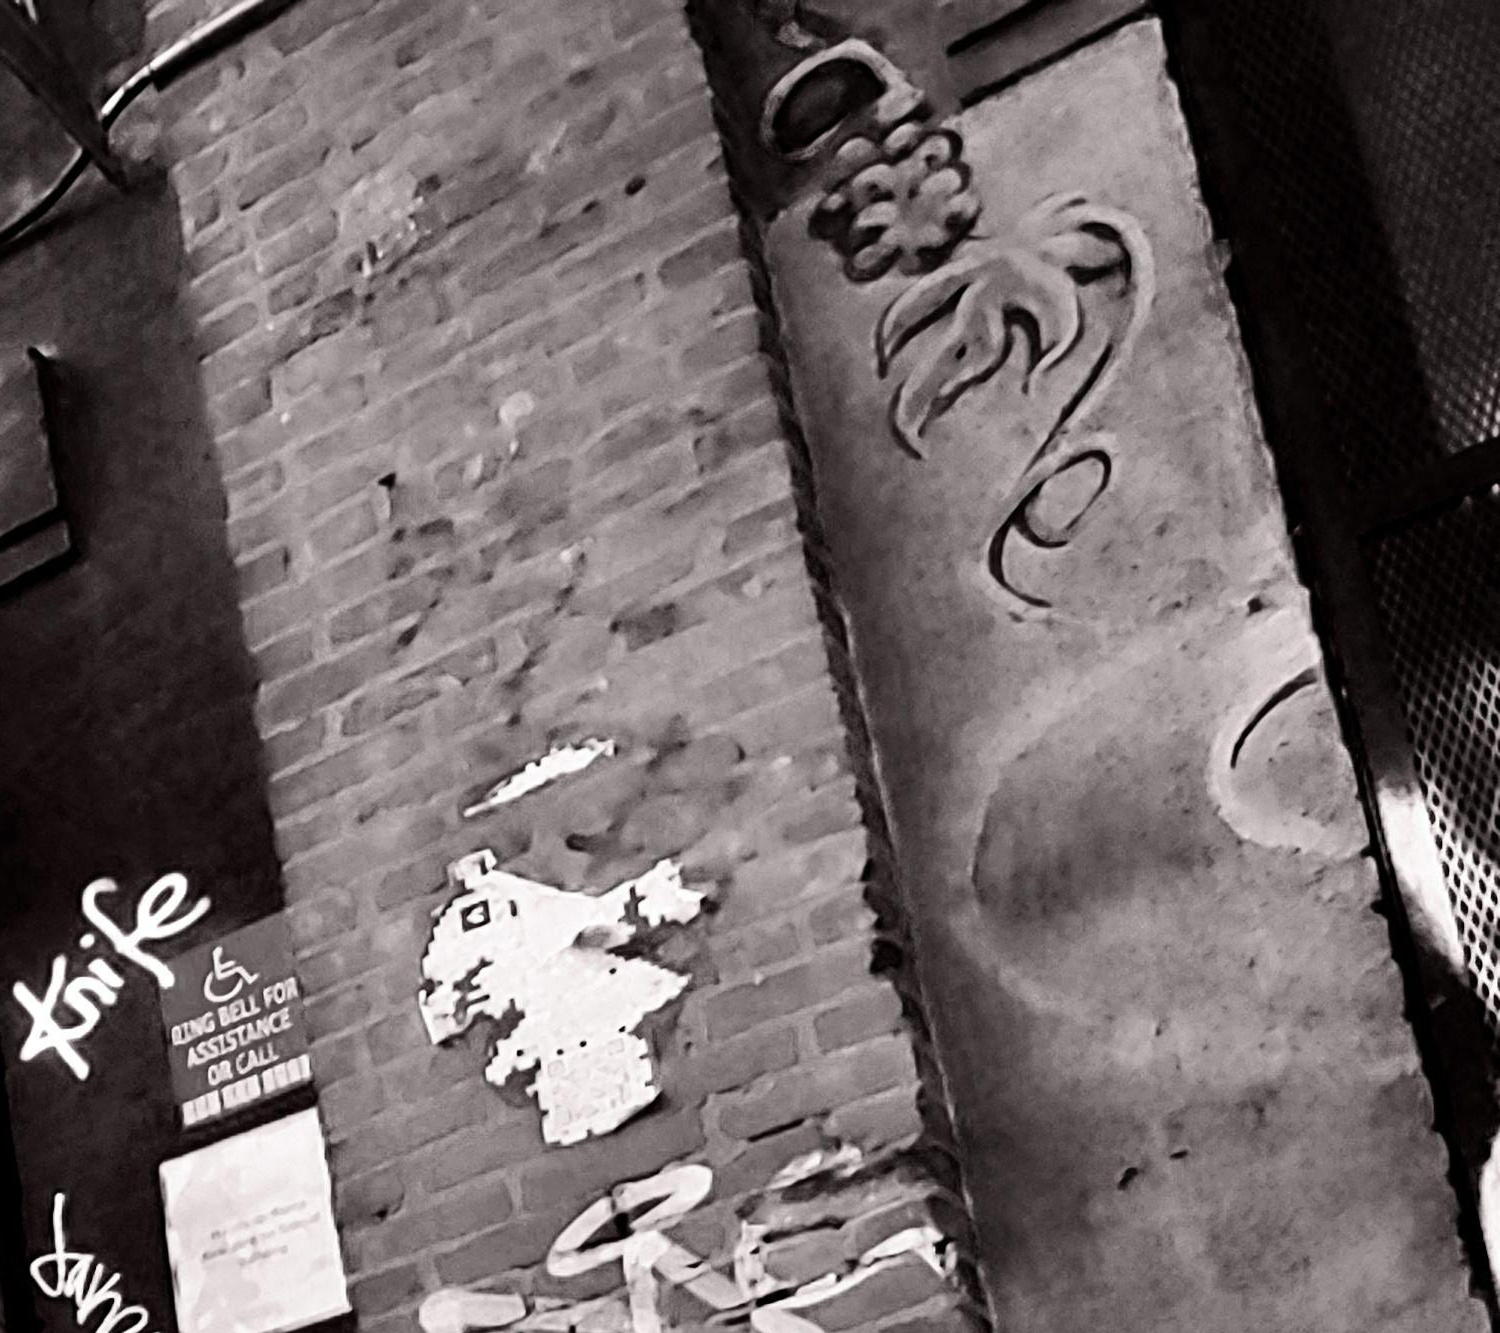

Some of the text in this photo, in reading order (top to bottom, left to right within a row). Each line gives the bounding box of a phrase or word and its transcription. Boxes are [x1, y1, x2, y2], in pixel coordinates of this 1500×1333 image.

[171, 976, 299, 1046] RING BELL FOR
[187, 1006, 294, 1068] ASSISTANCE
[207, 1041, 280, 1086] OR CALL
